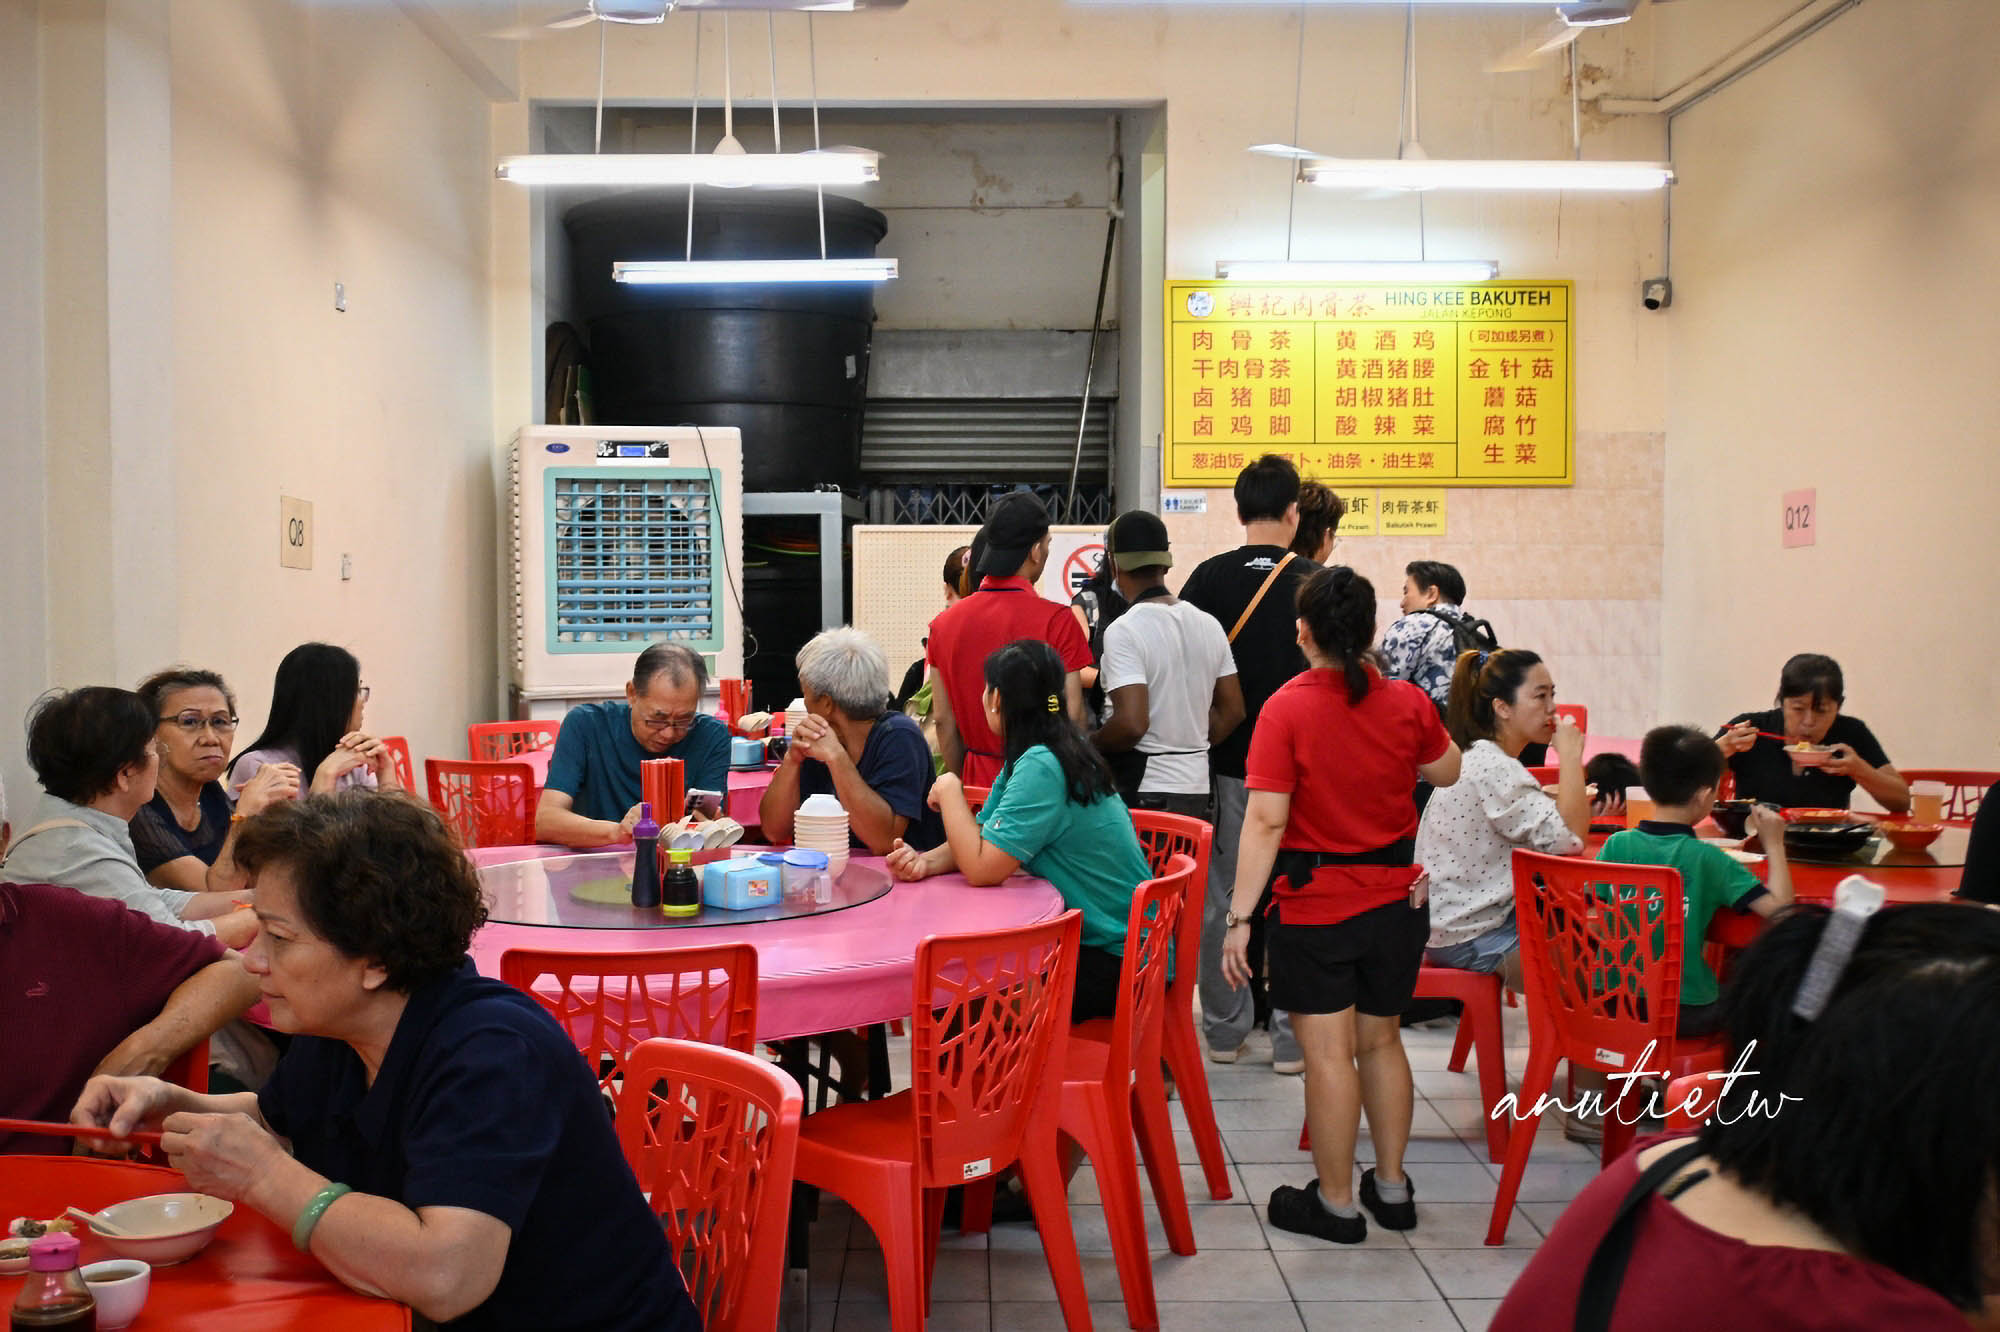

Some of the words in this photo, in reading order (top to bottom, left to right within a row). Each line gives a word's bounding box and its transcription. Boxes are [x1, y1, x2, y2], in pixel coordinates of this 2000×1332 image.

[1385, 291, 1428, 306] HING
[1433, 291, 1465, 306] KEE
[1470, 290, 1552, 306] BAKUTEH
[1461, 307, 1513, 320] KEPONG
[1192, 330, 1291, 351] 肉骨茶
[1336, 330, 1435, 351] 黄酒鸡
[1192, 358, 1291, 380] 干肉骨茶
[1336, 358, 1435, 380] 黄酒猪腰
[1468, 357, 1554, 379] 金针菇
[1192, 386, 1291, 408] 卤猪脚
[1335, 386, 1435, 409] 胡椒猪肚
[1192, 415, 1291, 437] 卤鸡脚
[1335, 414, 1435, 437] 酸辣菜
[1483, 414, 1537, 437] 腐竹
[1483, 443, 1537, 465] 生菜
[1381, 499, 1439, 515] 肉骨茶虾
[1785, 504, 1810, 531] Q12
[288, 517, 304, 547] Q8
